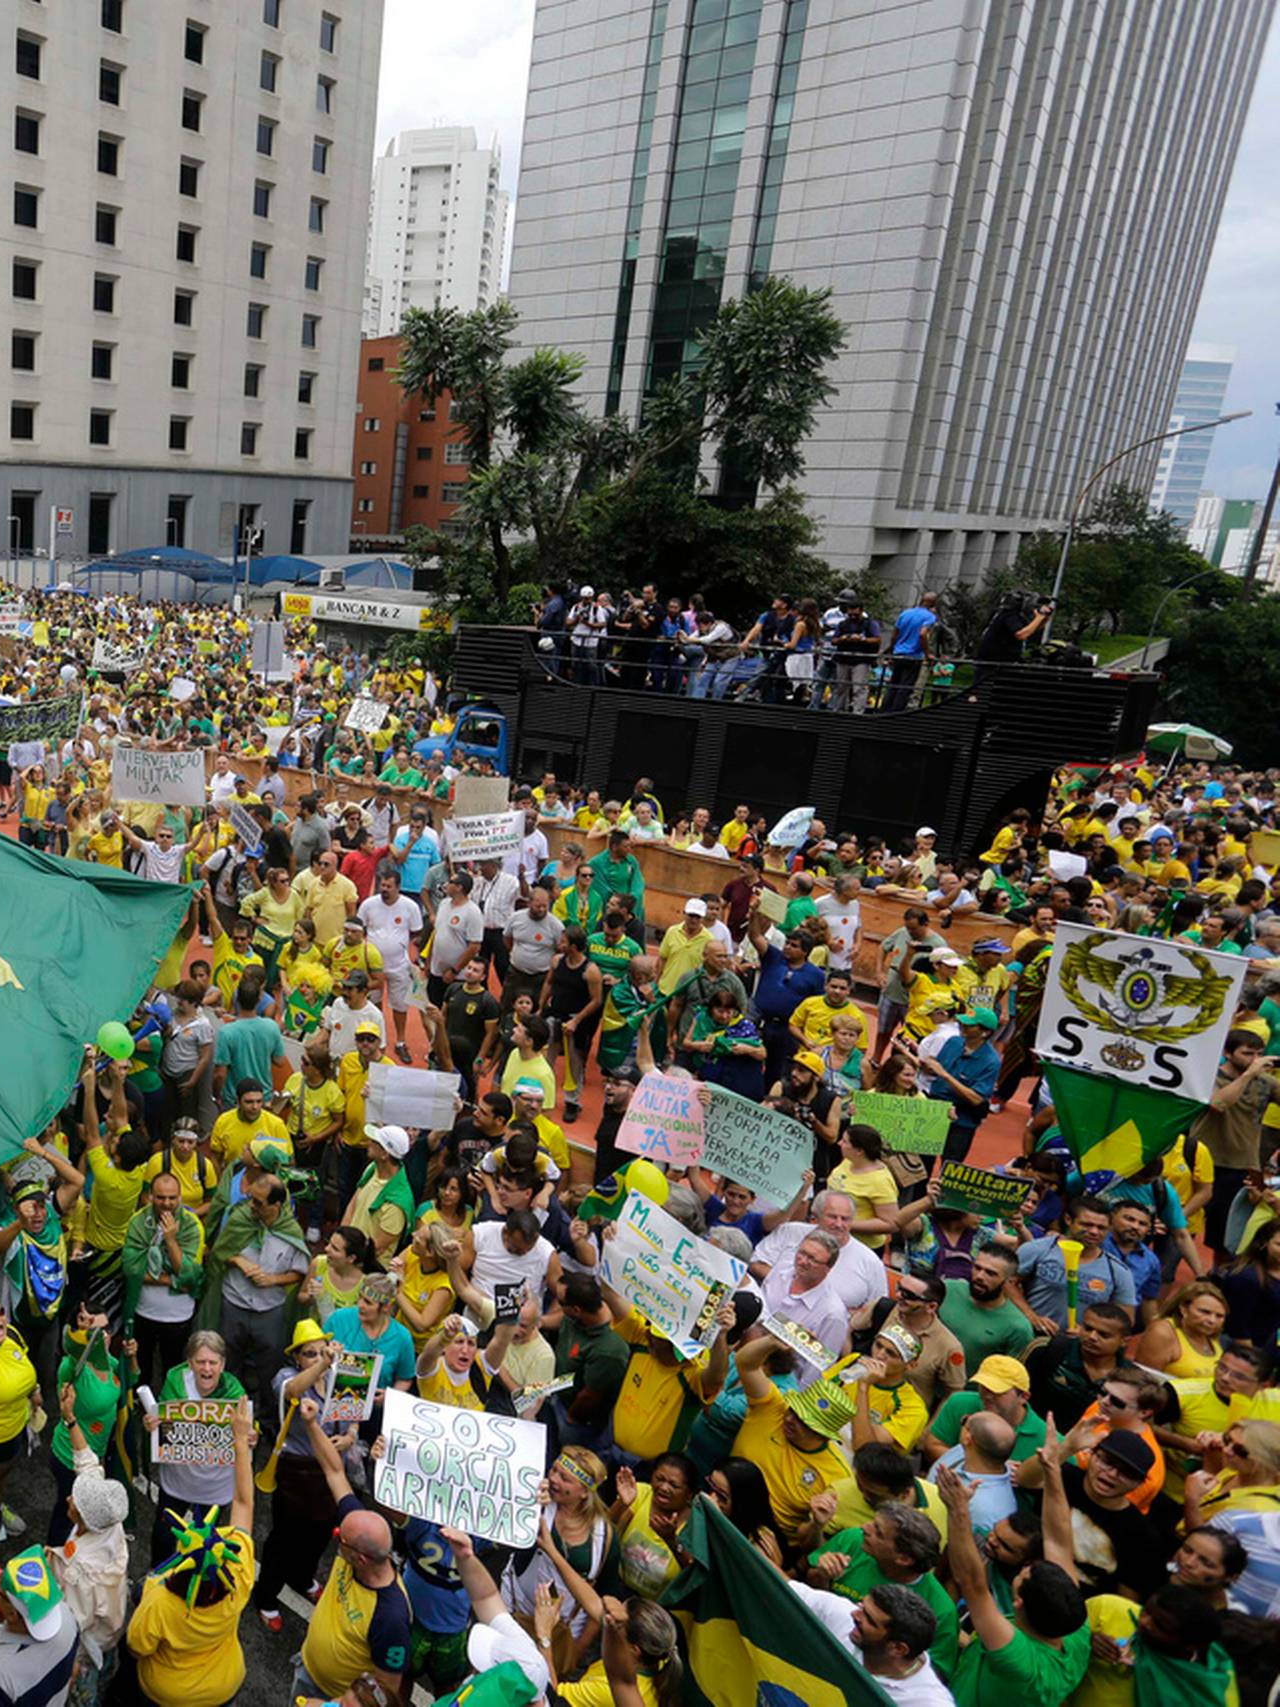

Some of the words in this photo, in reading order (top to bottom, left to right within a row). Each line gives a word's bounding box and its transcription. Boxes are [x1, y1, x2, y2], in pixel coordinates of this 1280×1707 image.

[126, 764, 184, 784] MILITAR
[590, 943, 629, 960] BRASIL
[724, 1110, 761, 1136] FORA
[765, 1129, 802, 1155] MST
[741, 1135, 781, 1163] FFAA
[943, 1162, 1030, 1194] Military
[166, 1401, 235, 1424] FORA
[160, 1444, 236, 1463] ABUSIVO
[376, 1465, 538, 1547] ARMADAS
